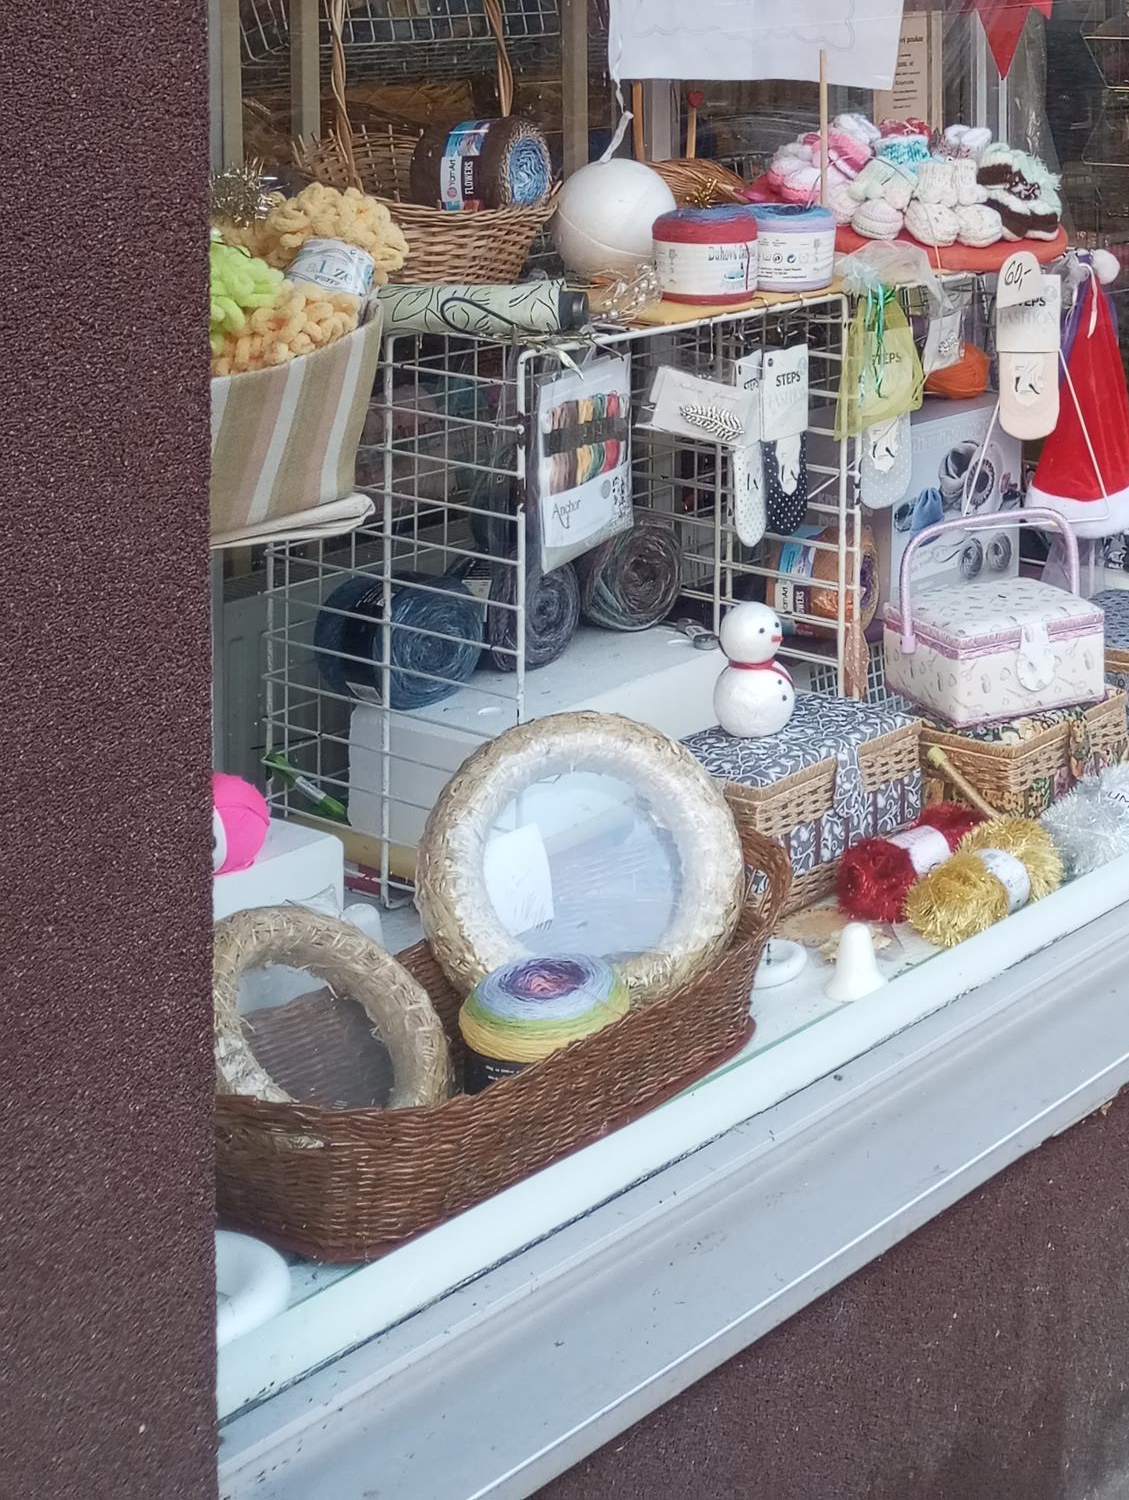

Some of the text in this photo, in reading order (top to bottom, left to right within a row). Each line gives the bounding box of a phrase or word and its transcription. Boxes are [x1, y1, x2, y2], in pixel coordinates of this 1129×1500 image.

[464, 160, 474, 195] FLOWERS
[775, 370, 801, 388] STEPS
[552, 499, 581, 530] Anchor
